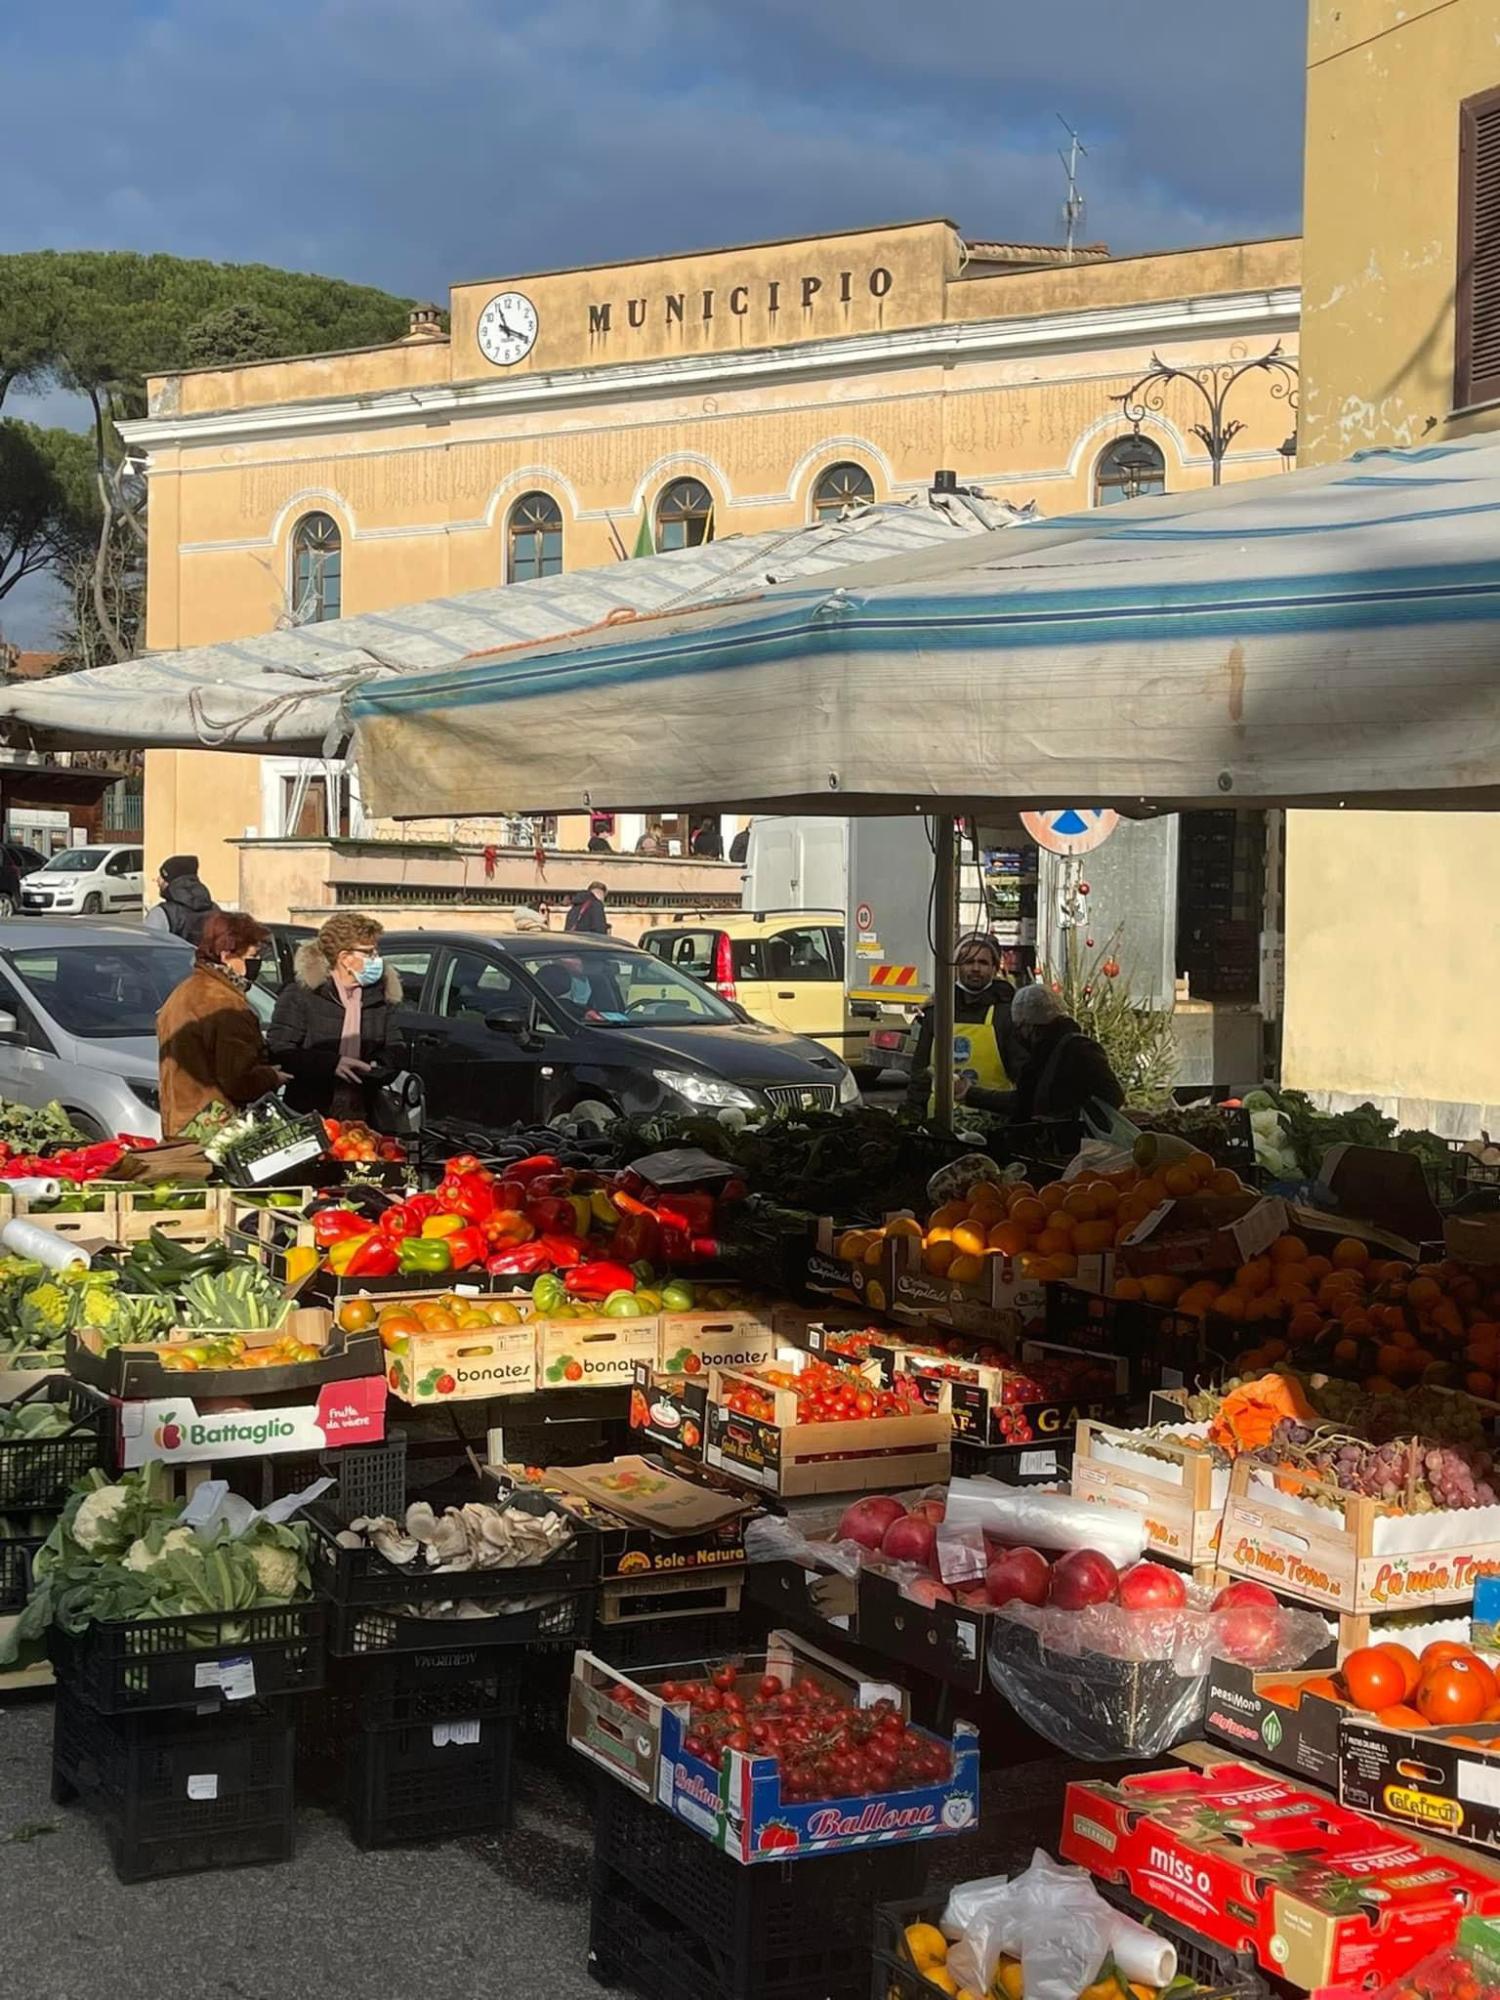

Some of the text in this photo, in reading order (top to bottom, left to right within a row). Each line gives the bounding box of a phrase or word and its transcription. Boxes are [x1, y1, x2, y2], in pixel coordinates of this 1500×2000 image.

[589, 267, 892, 334] MUNICIPIO
[457, 1364, 531, 1382] bonates
[584, 1358, 637, 1374] bonat
[702, 1351, 768, 1366] bonates
[190, 1418, 295, 1445] Battaglio
[655, 1552, 687, 1569] Sole
[697, 1547, 745, 1565] Natura
[1233, 1537, 1255, 1566] La
[1256, 1550, 1286, 1576] mia
[1370, 1564, 1405, 1603] La
[1406, 1562, 1449, 1593] mia
[675, 1762, 725, 1814] Ballone
[808, 1802, 936, 1840] Ballone
[1151, 1846, 1194, 1885] miss
